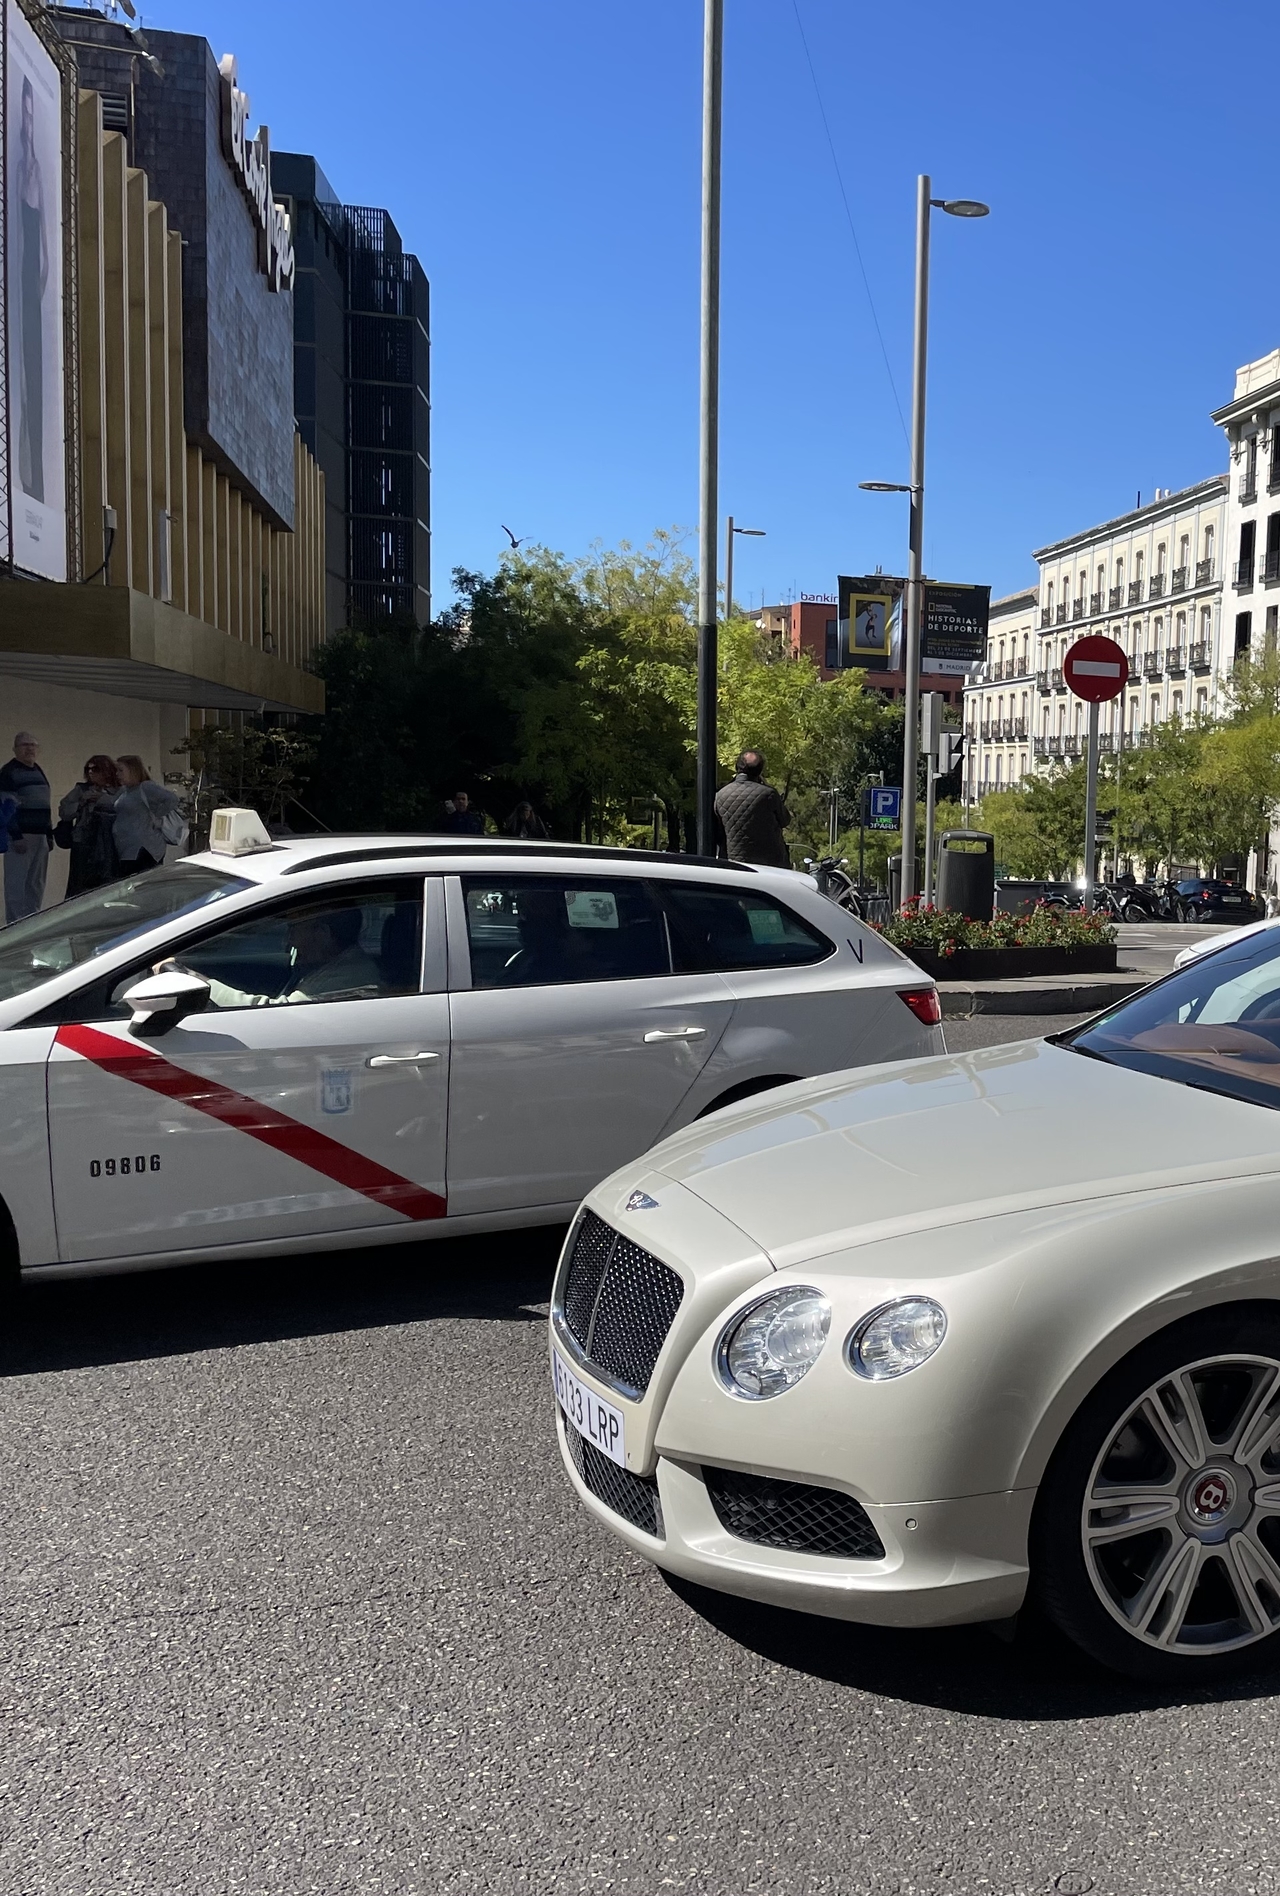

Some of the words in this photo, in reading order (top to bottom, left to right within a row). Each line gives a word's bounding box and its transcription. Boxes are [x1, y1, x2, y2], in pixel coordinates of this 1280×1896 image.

[928, 615, 977, 625] HISTORIAS
[928, 623, 939, 631] DE
[943, 625, 983, 634] DEPORTE
[876, 792, 894, 814] P
[846, 938, 864, 964] V
[90, 1154, 161, 1178] 09806
[587, 1397, 619, 1453] LRP
